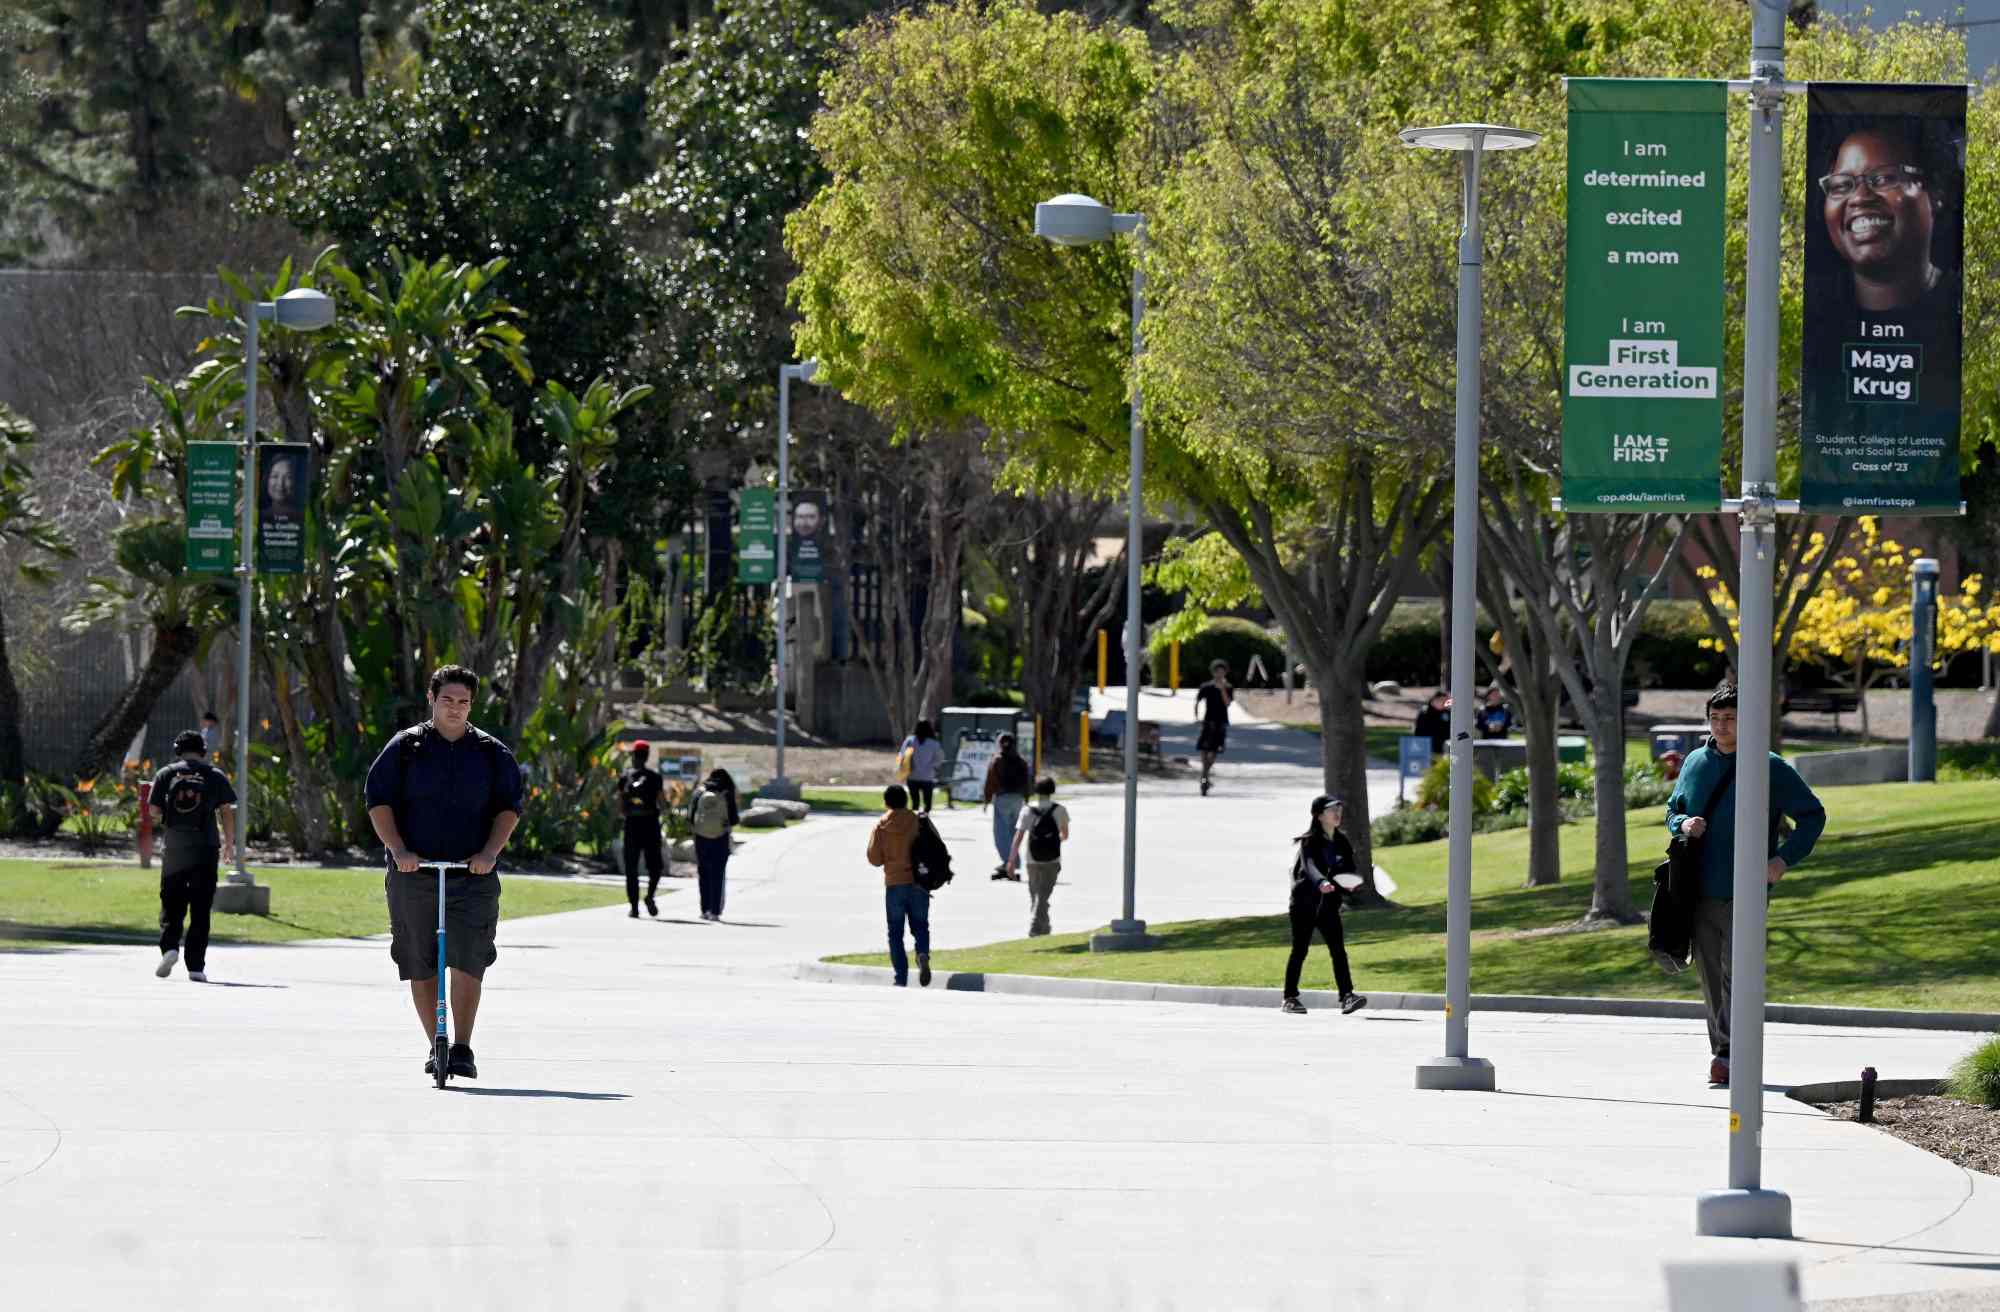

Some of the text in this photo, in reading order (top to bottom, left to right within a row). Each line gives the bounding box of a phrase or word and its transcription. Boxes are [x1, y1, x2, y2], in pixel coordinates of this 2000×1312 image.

[1623, 140, 1667, 156] I am
[1583, 169, 1706, 188] determined
[1605, 207, 1683, 226] excited
[1607, 250, 1680, 265] a mom
[1622, 317, 1666, 334] I am
[1860, 320, 1905, 338] I am
[1617, 345, 1670, 365] First
[1850, 349, 1915, 373] Maya
[1576, 370, 1710, 390] Generation
[1853, 376, 1911, 400] Krug
[1613, 434, 1653, 448] I AM
[1815, 433, 1946, 447] Student, College of Letters,
[1612, 447, 1669, 463] FIRST
[1820, 446, 1940, 457] Arts, and Social Sciences
[1852, 462, 1879, 471] Class
[1880, 462, 1892, 471] of
[1596, 492, 1686, 504] cpp.edu/iamfirst
[1841, 495, 1916, 508] @iamfirstcpp
